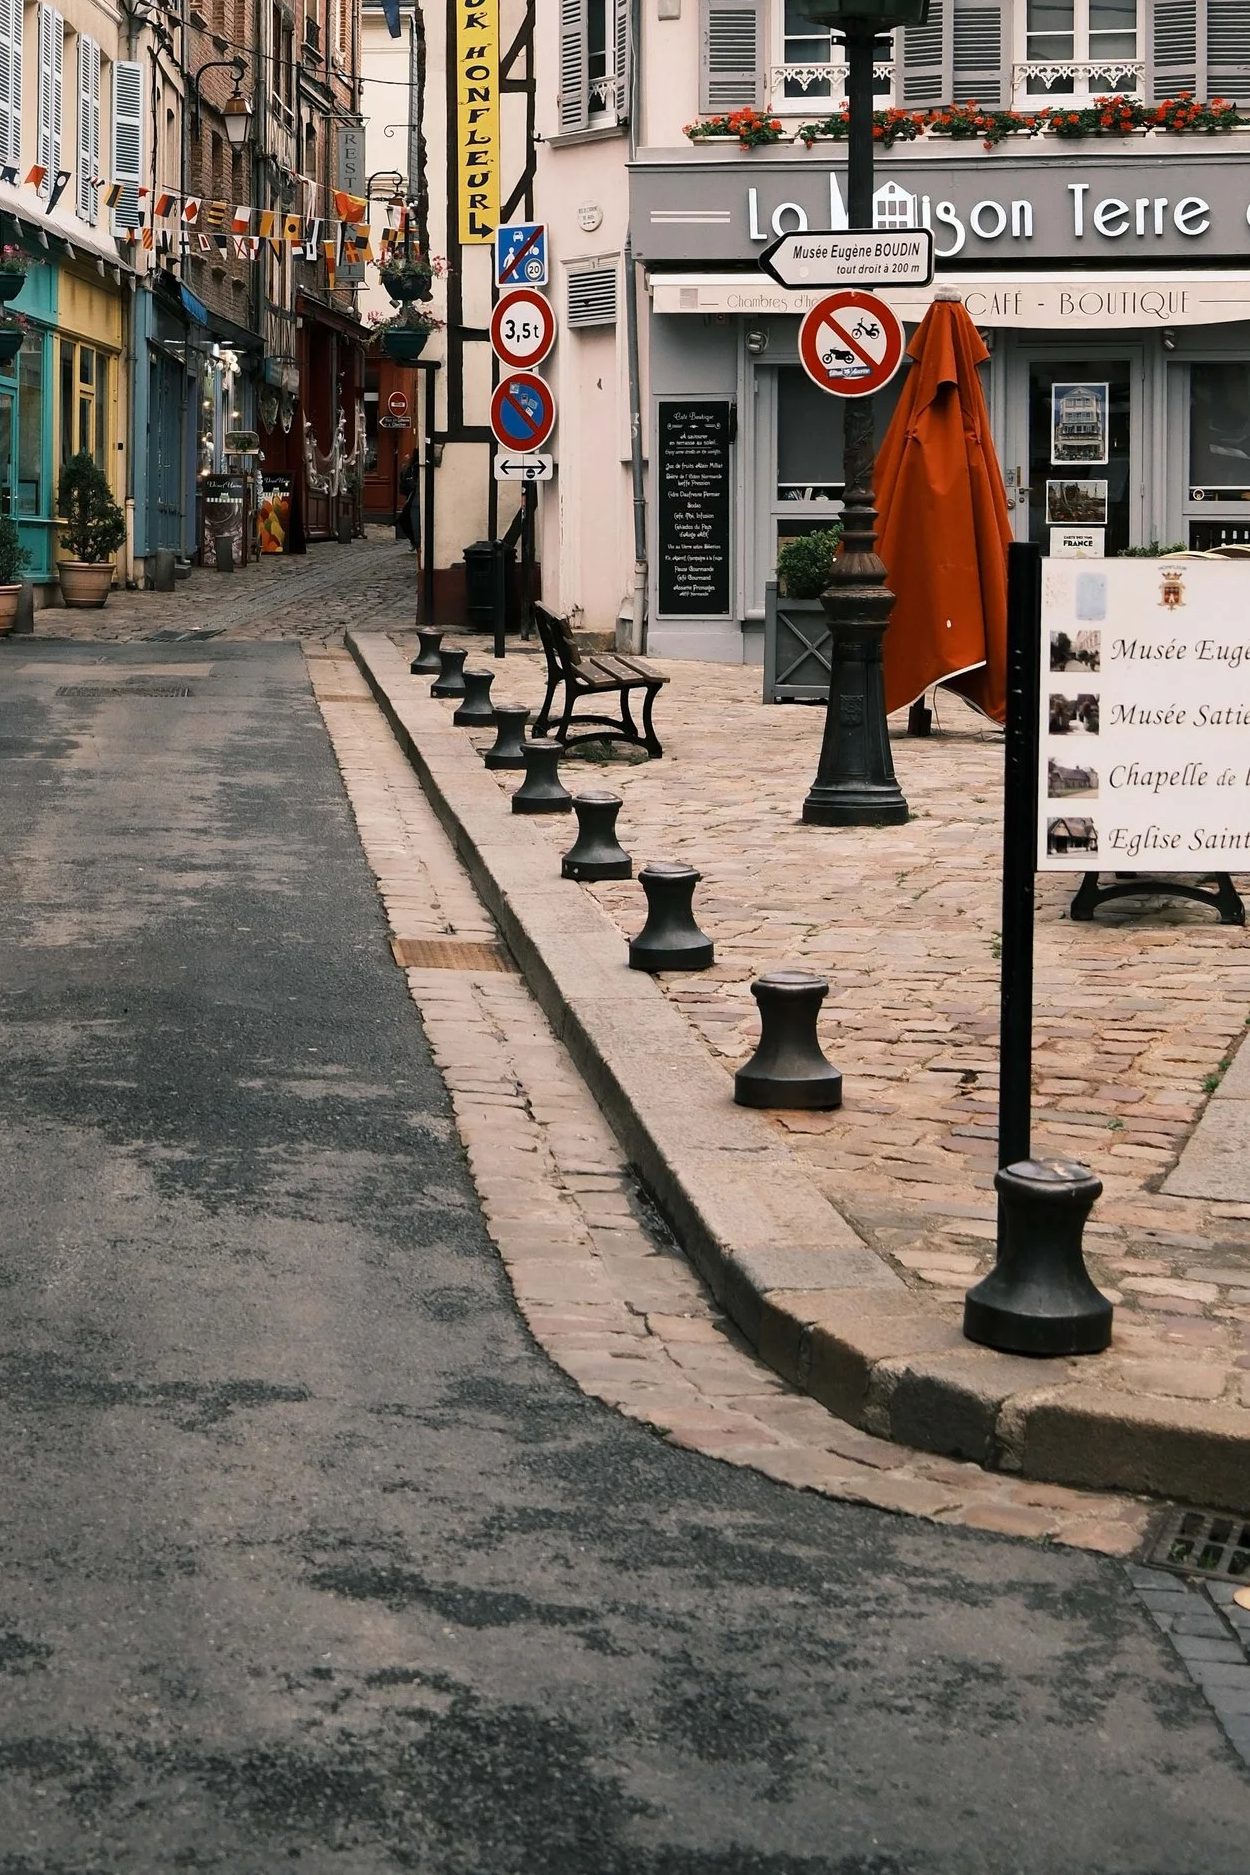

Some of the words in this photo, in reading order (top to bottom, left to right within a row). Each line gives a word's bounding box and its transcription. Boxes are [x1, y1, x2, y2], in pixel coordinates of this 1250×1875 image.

[458, 43, 494, 210] HONFLEUR
[1067, 183, 1210, 237] Terre
[793, 245, 828, 259] Musée
[830, 244, 872, 261] Eugène
[874, 242, 920, 257] BOUDIN
[528, 264, 541, 274] 20
[837, 265, 857, 275] tout
[858, 264, 881, 274] droit
[892, 263, 909, 273] 200
[911, 265, 920, 273] m
[727, 294, 788, 312] Chambres
[964, 290, 1023, 316] CAFÉ
[1060, 291, 1190, 320] BOUTIQUE
[1110, 638, 1187, 660] Musée
[1110, 703, 1186, 725] Musée
[1193, 703, 1250, 727] Satie
[1109, 763, 1208, 794] Chapelle
[1216, 768, 1236, 787] de
[1108, 825, 1181, 857] Eglise
[1188, 828, 1250, 851] Saint
